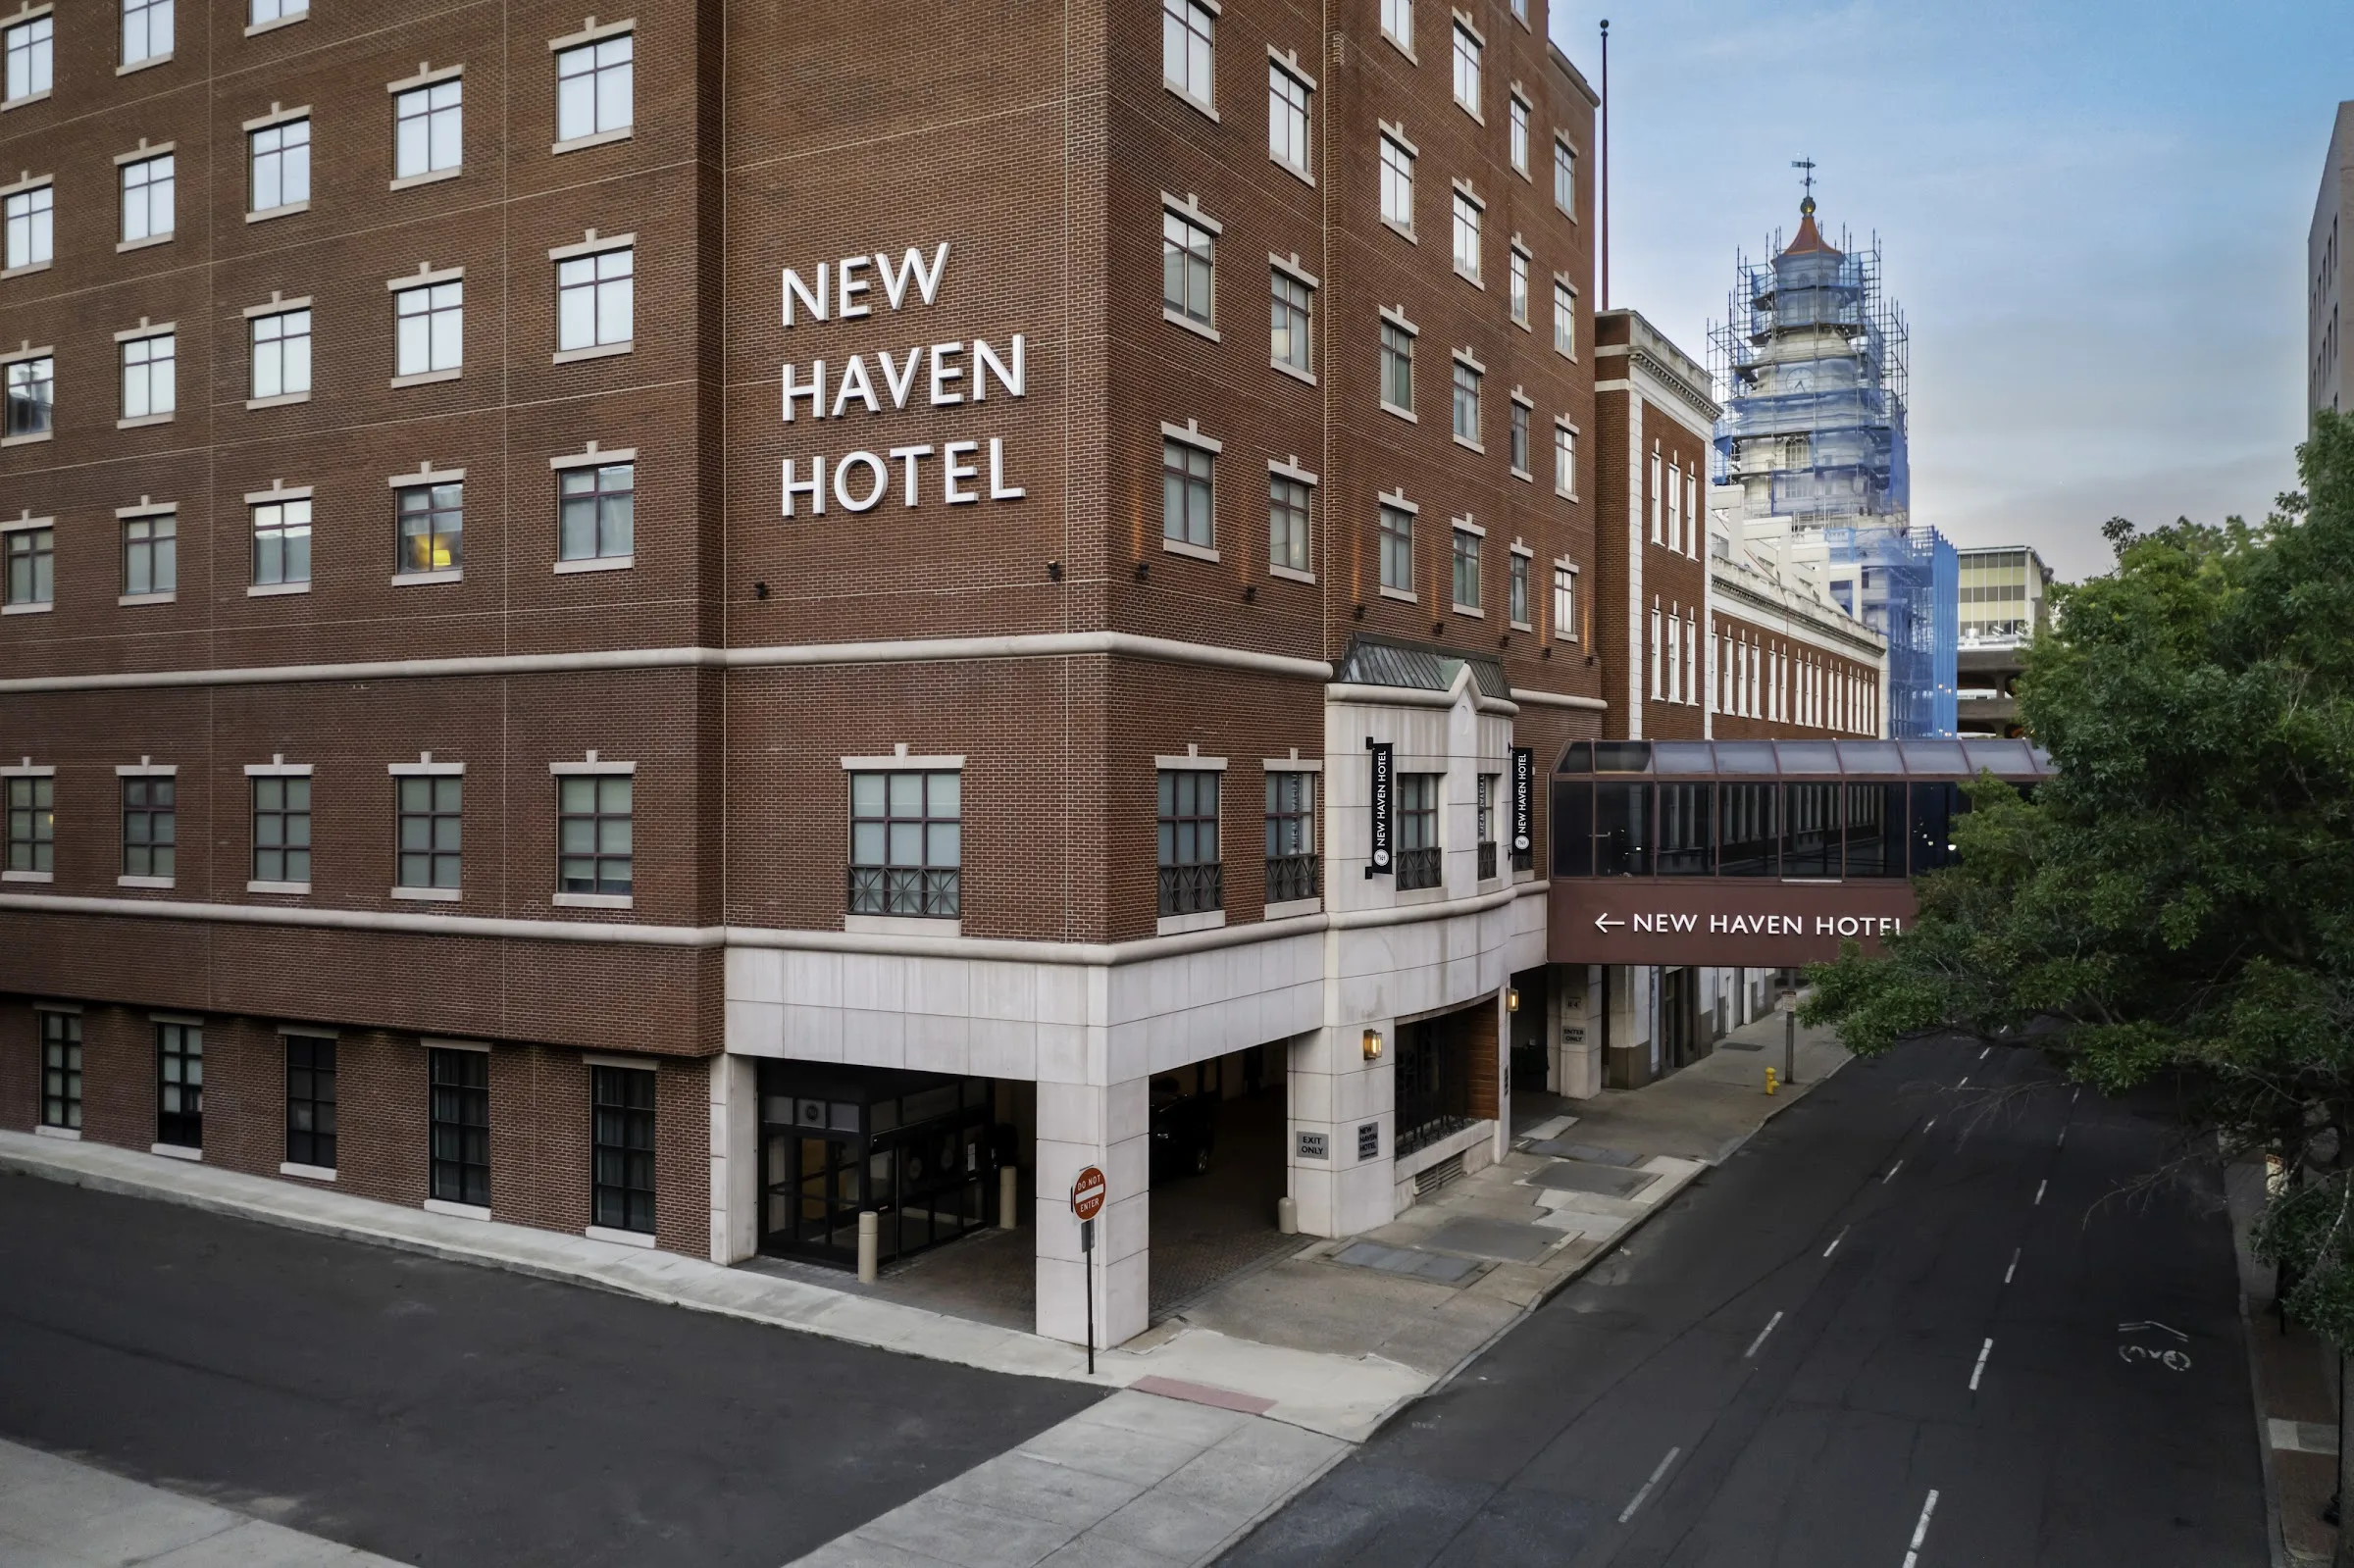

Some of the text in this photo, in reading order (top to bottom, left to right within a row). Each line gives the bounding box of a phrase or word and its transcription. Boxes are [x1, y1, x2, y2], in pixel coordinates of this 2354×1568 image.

[782, 242, 951, 327] NEW
[782, 333, 1025, 422] HAVEN
[782, 437, 1026, 517] HOTEL
[1377, 750, 1386, 846] NEW HAVEN HOTEL
[1633, 913, 1901, 936] NEW HAVEN HOTEL
[1359, 1125, 1372, 1135] NEW
[1359, 1133, 1377, 1143] HAVEN
[1303, 1136, 1322, 1145] EXIT
[1359, 1141, 1377, 1152] HOTEL
[1302, 1145, 1323, 1155] ONLY
[1077, 1174, 1100, 1190] DO NOT
[1080, 1197, 1100, 1213] ENTER
